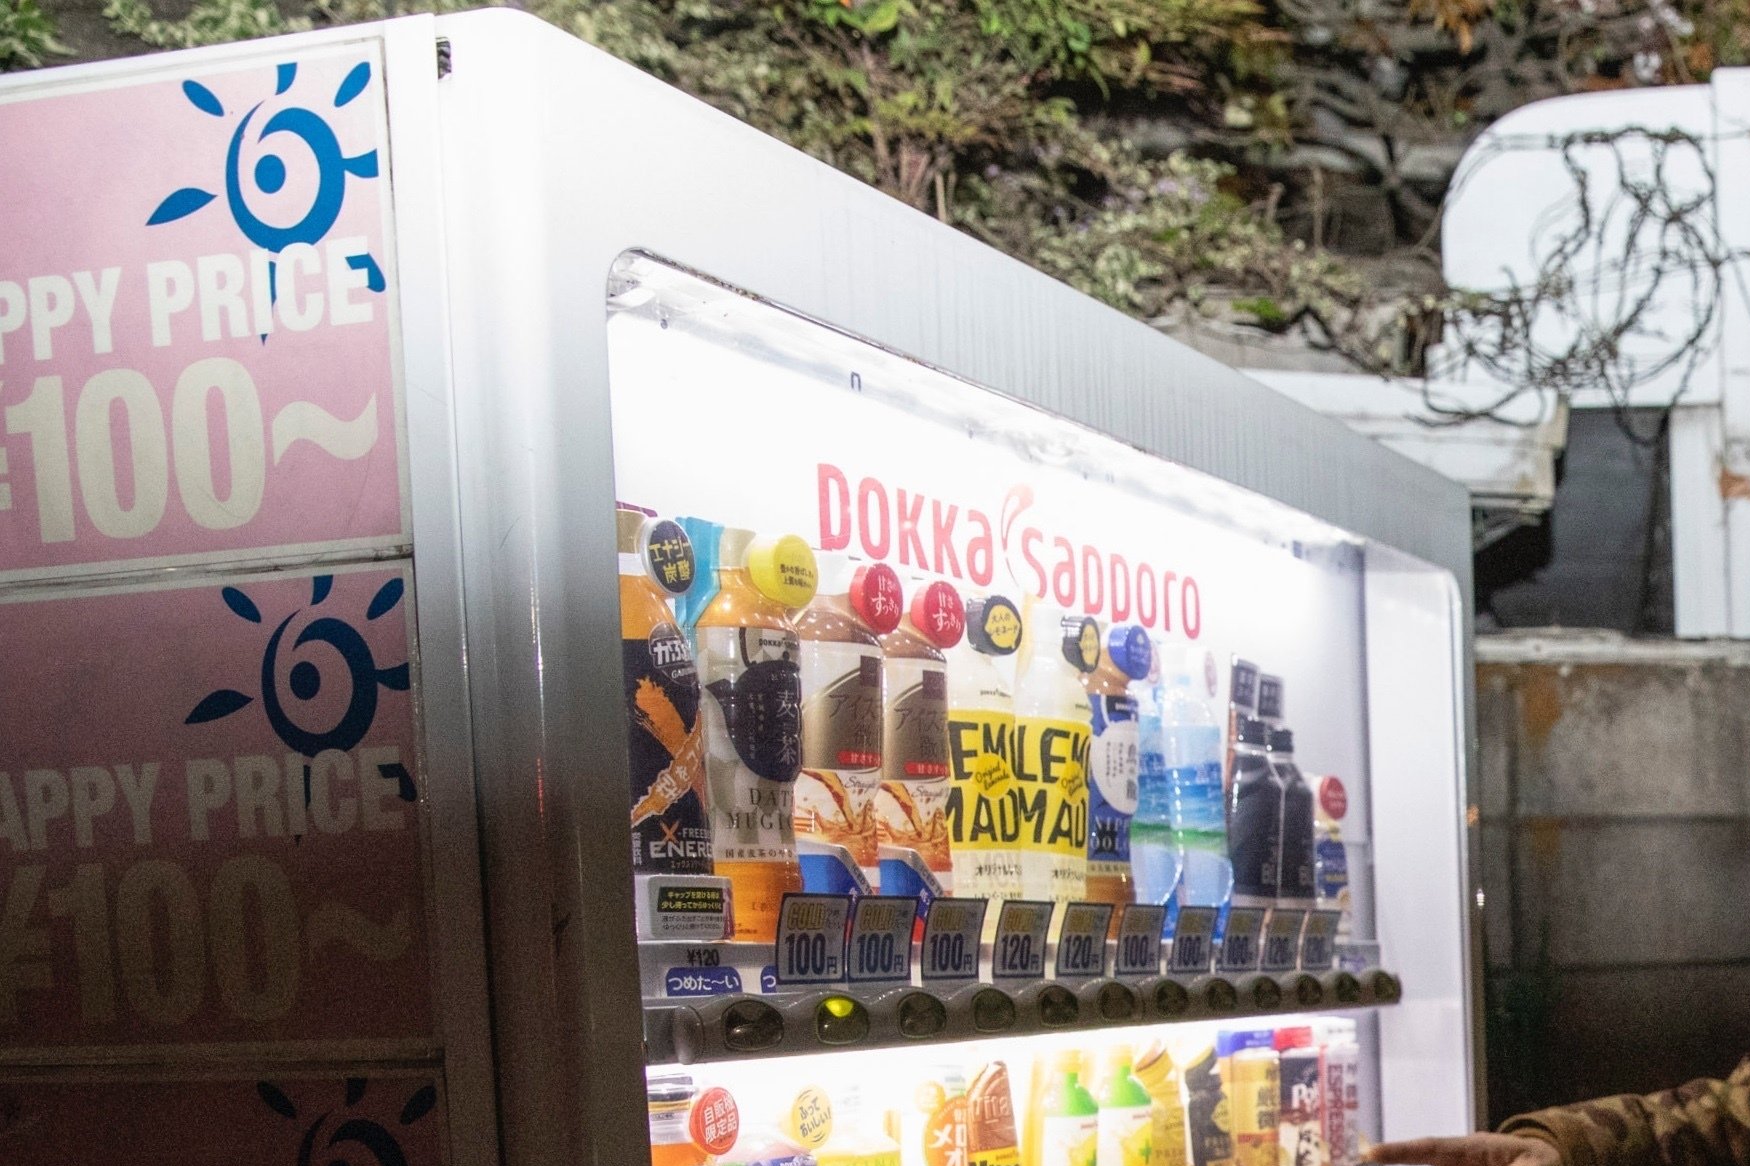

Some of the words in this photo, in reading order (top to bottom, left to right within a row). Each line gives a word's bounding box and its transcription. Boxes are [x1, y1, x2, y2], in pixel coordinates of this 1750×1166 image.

[148, 236, 374, 348] PRICE
[185, 746, 405, 841] PRICE
[788, 902, 824, 931] GOLD
[785, 932, 838, 975] 100円
[857, 932, 904, 973] 100円
[705, 1112, 738, 1145] 限定品
